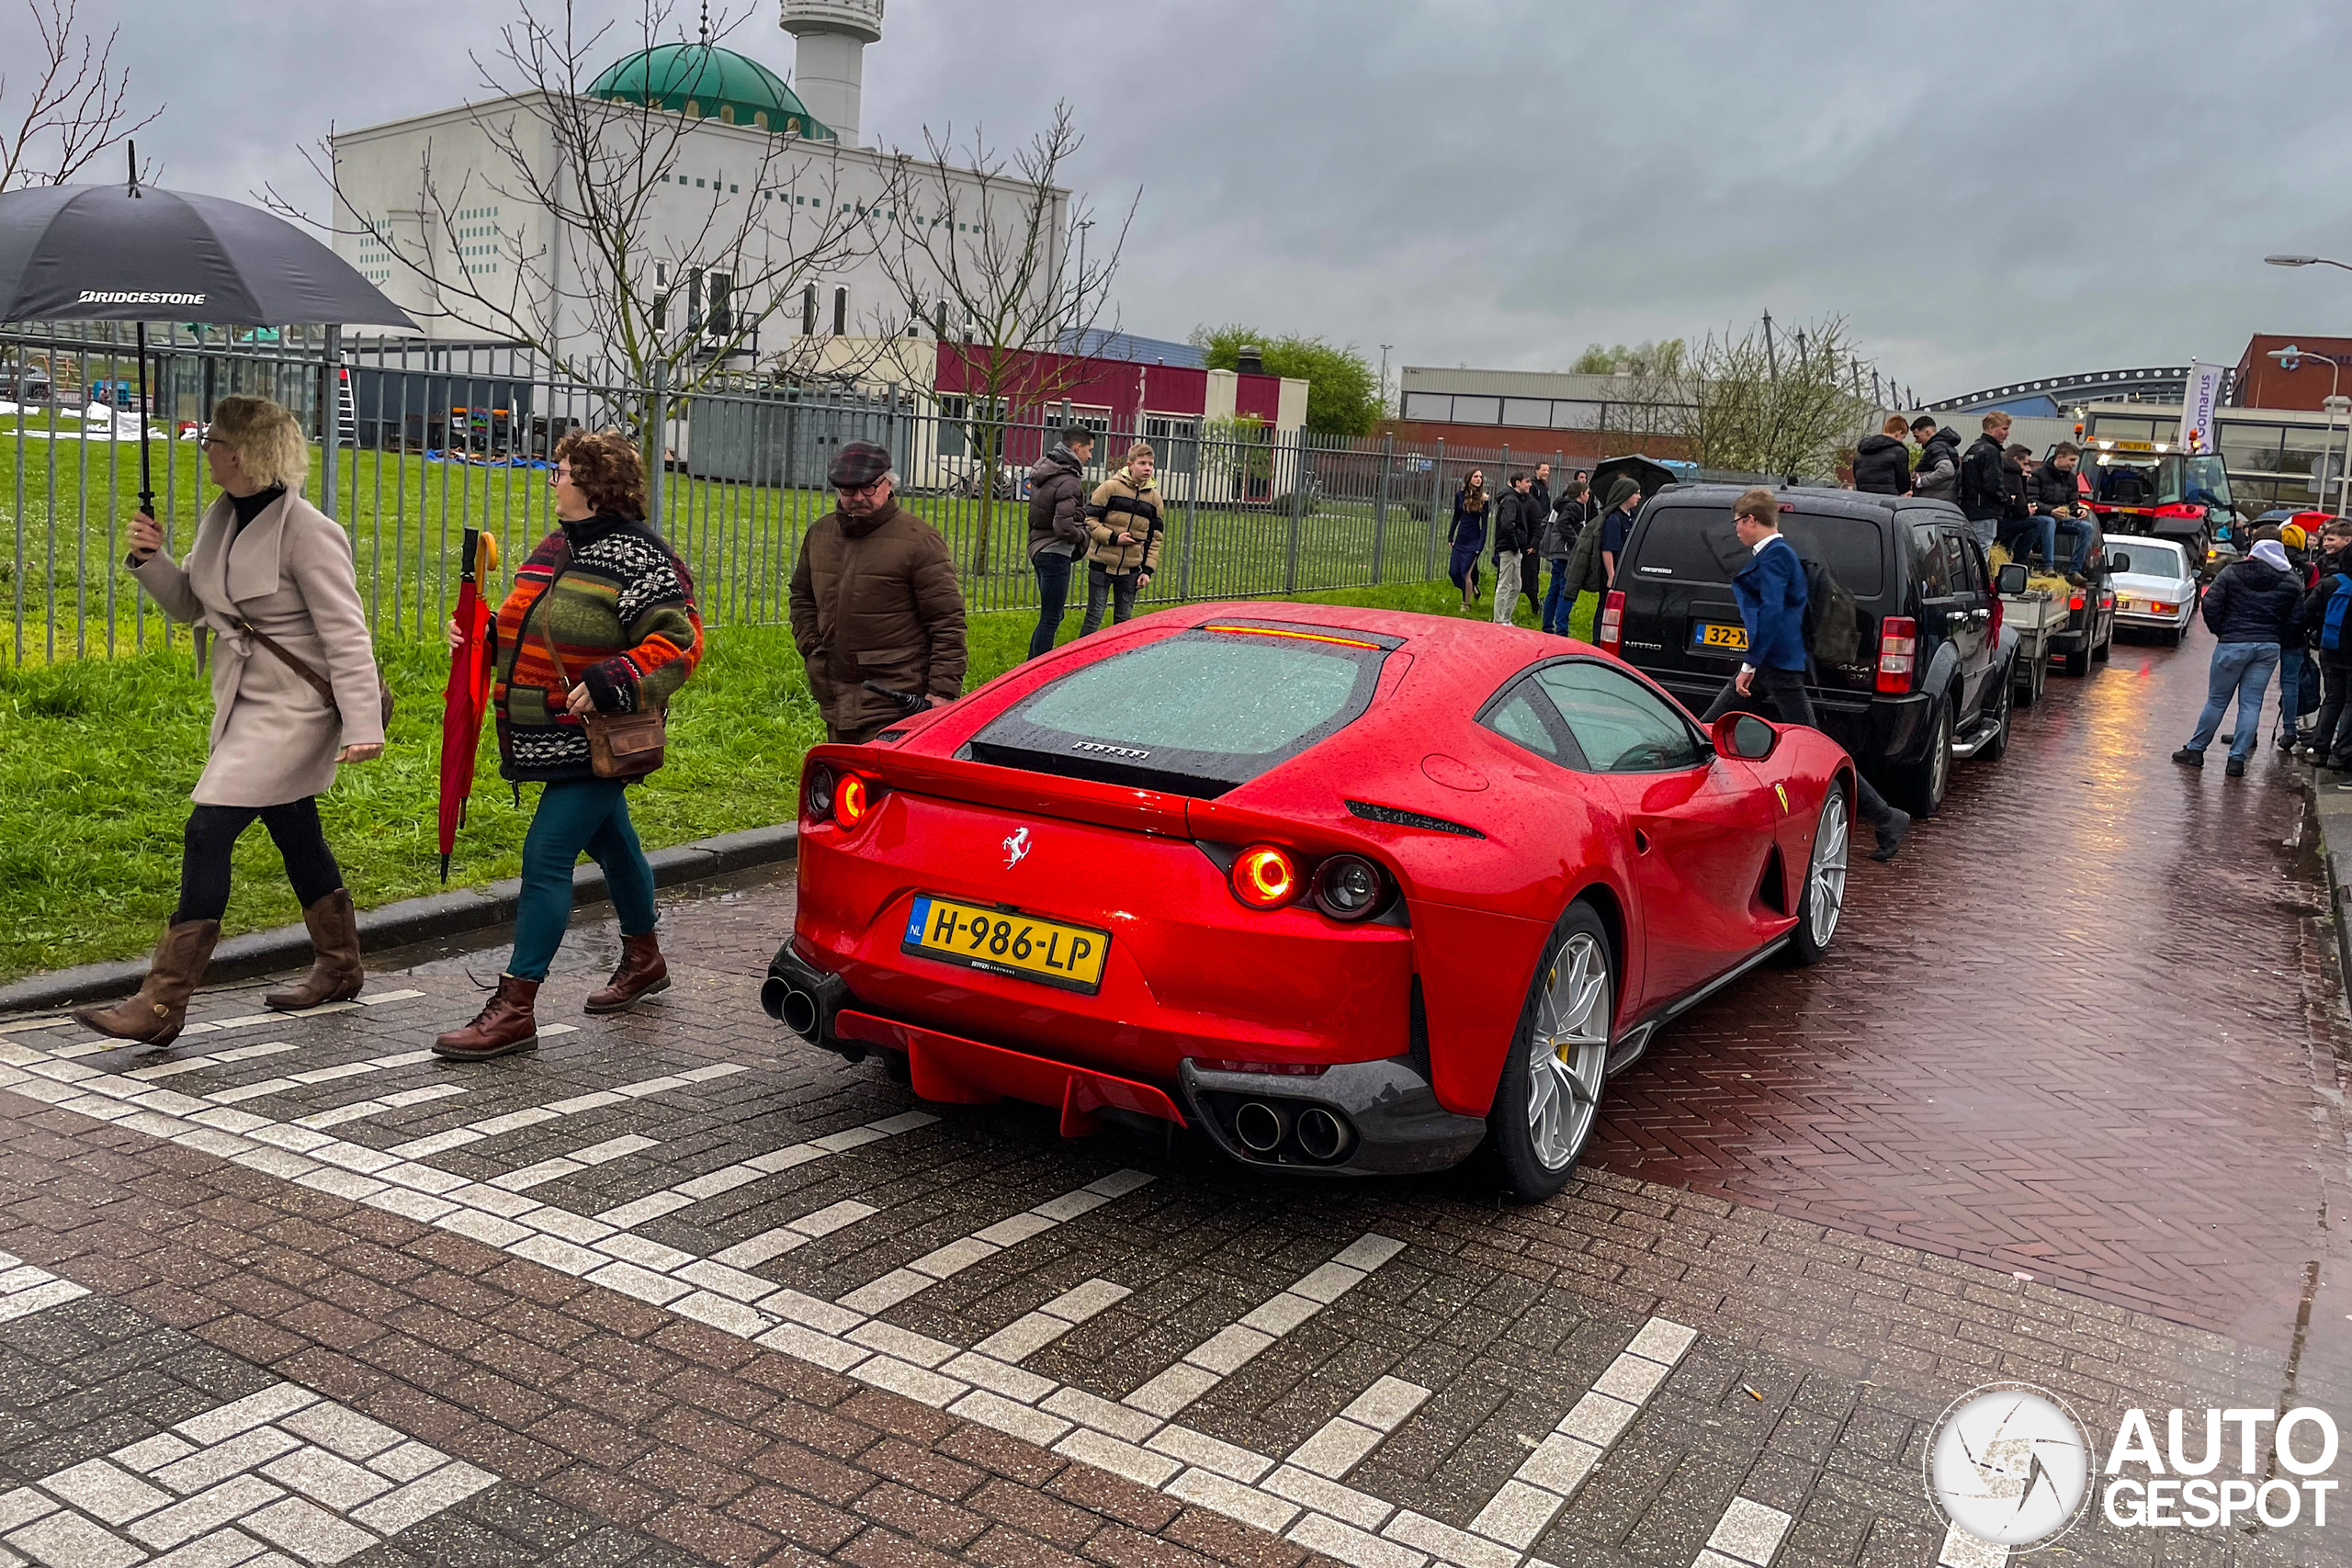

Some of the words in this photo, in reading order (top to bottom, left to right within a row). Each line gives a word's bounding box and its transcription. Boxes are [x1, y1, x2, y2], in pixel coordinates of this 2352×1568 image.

[78, 290, 206, 304] BRIDGESTONE
[2197, 374, 2211, 438] Gomarus
[1625, 640, 1662, 650] NITRO
[1072, 741, 1150, 760] Ferrari
[910, 924, 922, 937] NL
[933, 908, 1091, 972] H-986-LP
